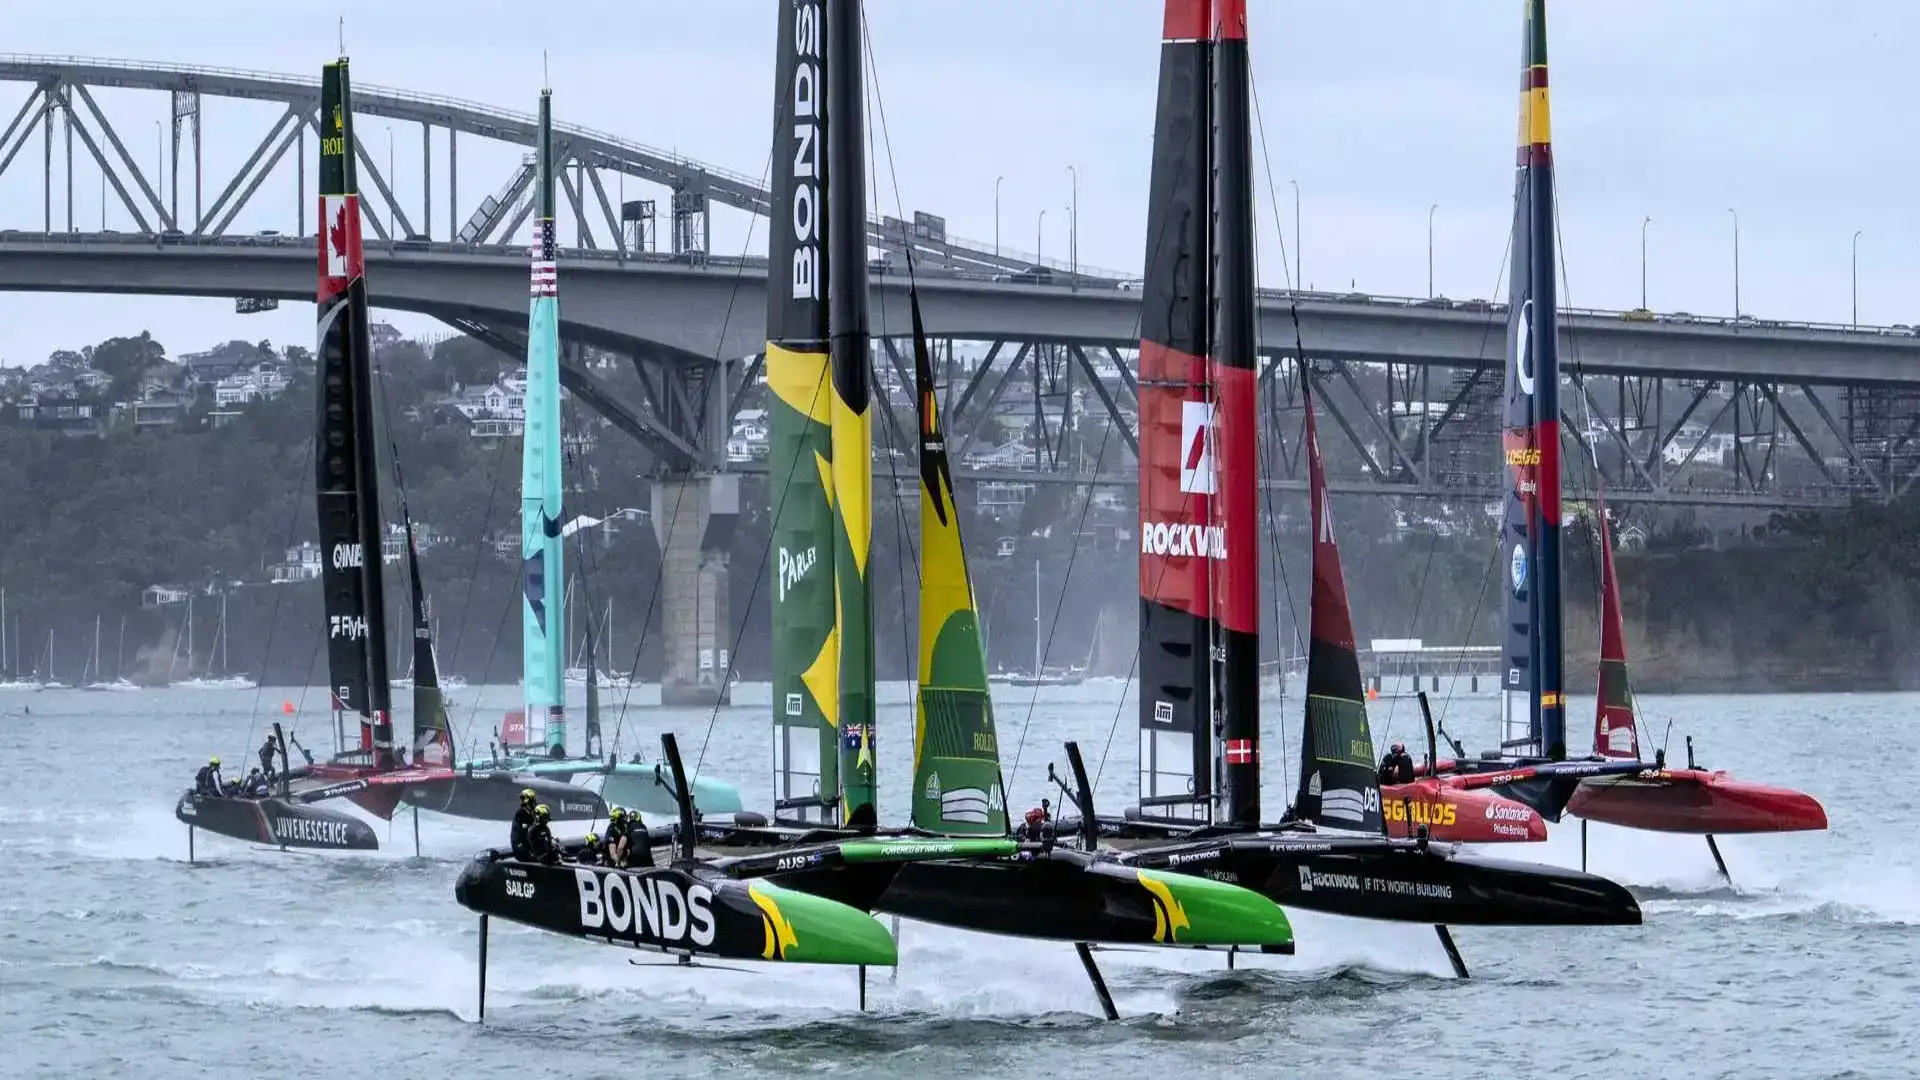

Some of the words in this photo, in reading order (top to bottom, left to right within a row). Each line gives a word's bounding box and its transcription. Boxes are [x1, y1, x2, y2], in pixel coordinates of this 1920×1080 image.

[792, 4, 815, 299] BONDS
[778, 545, 817, 603] PARLEY
[1364, 786, 1380, 813] DEN
[1495, 803, 1533, 821] Santander
[275, 817, 349, 844] JUVENESCENCE
[776, 855, 806, 871] AUS
[1180, 850, 1220, 864] ROCKWOOL
[1313, 872, 1360, 891] ROCKWOOL
[1364, 877, 1372, 890] IF
[1373, 877, 1386, 892] IT'S
[1386, 879, 1415, 895] WORTH
[1416, 881, 1452, 899] BUILDING
[574, 868, 716, 946] BONDS
